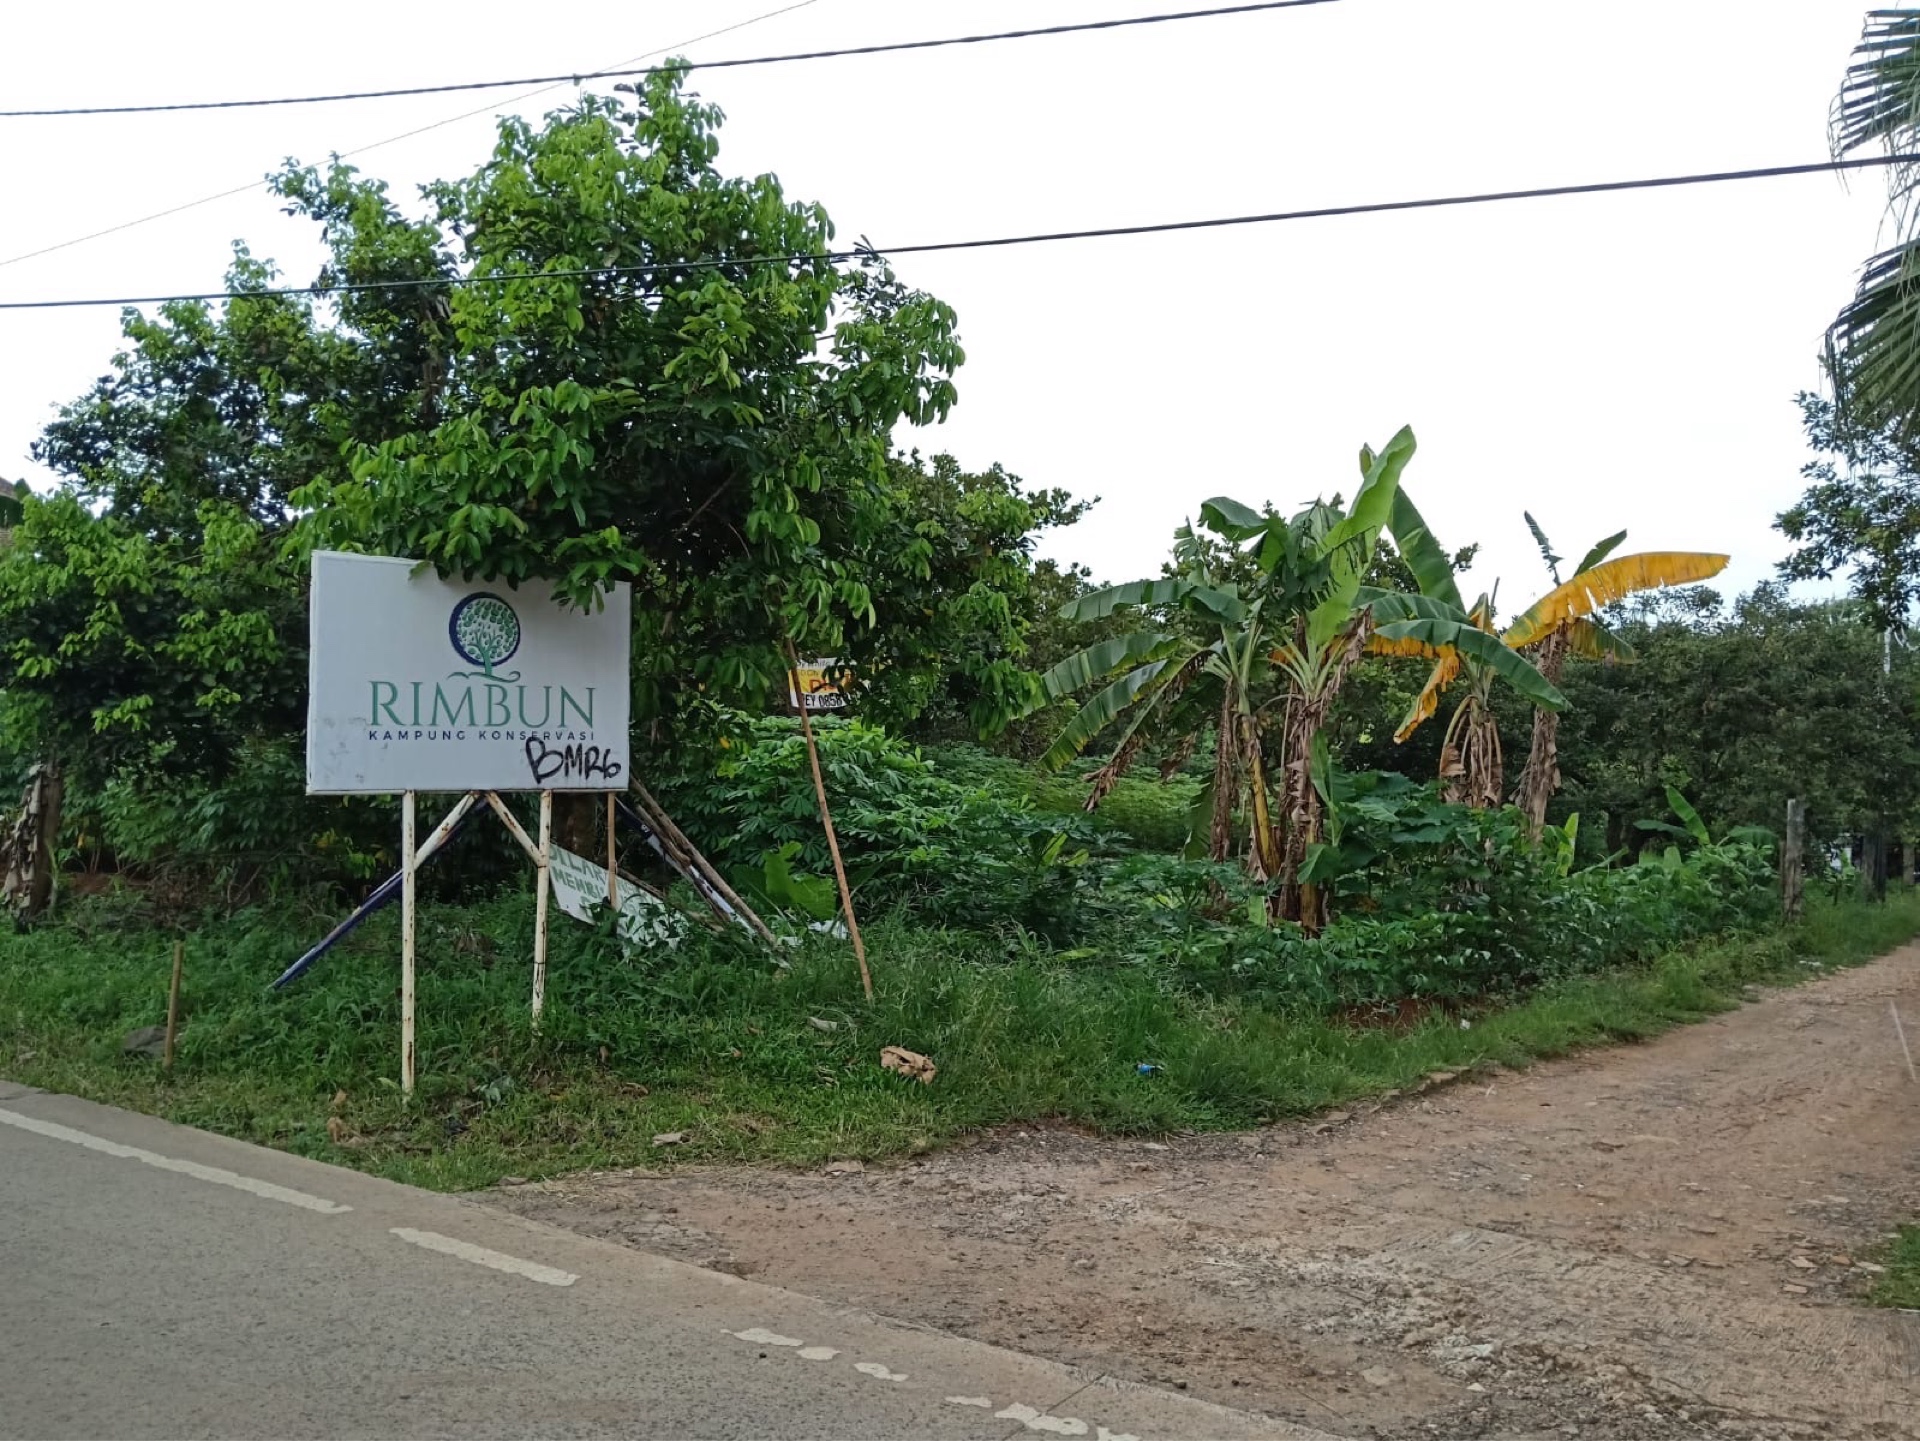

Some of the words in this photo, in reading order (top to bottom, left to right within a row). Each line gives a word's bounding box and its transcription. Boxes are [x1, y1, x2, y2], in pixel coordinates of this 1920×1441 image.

[369, 680, 595, 728] RIMBUN
[369, 729, 466, 741] KAMPUNG
[479, 729, 594, 741] KONSERVASI
